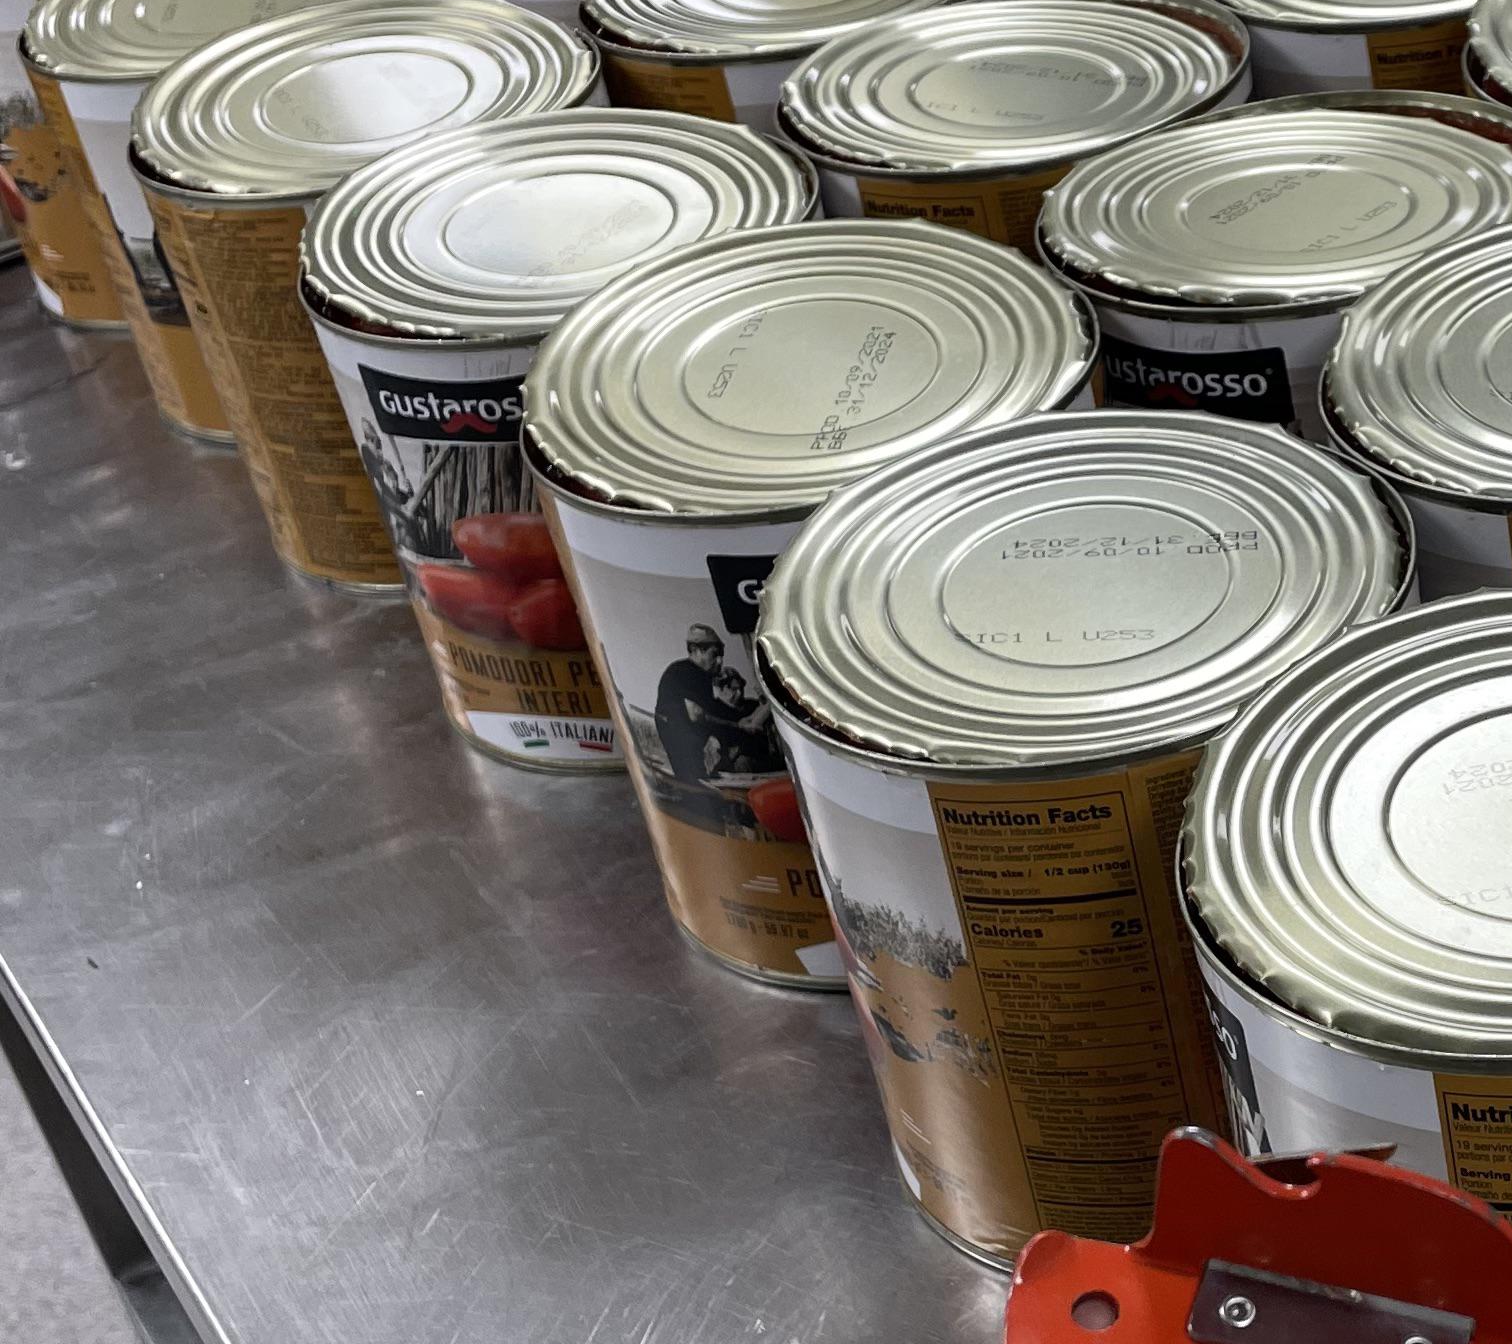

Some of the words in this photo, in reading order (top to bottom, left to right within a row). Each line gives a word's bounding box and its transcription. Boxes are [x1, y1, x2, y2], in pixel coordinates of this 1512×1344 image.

[1106, 355, 1267, 397] ustarosso
[379, 390, 523, 422] Gustaros
[449, 641, 557, 687] POMODORI
[517, 690, 592, 714] INTERI
[510, 721, 546, 738] 100%
[942, 807, 1040, 826] Nutrition
[1048, 805, 1112, 824] Facts
[956, 866, 997, 878] Serving
[971, 923, 1043, 938] Calories
[1110, 918, 1143, 938] 25
[1456, 1140, 1470, 1150] 19
[1460, 1167, 1511, 1182] Serving
